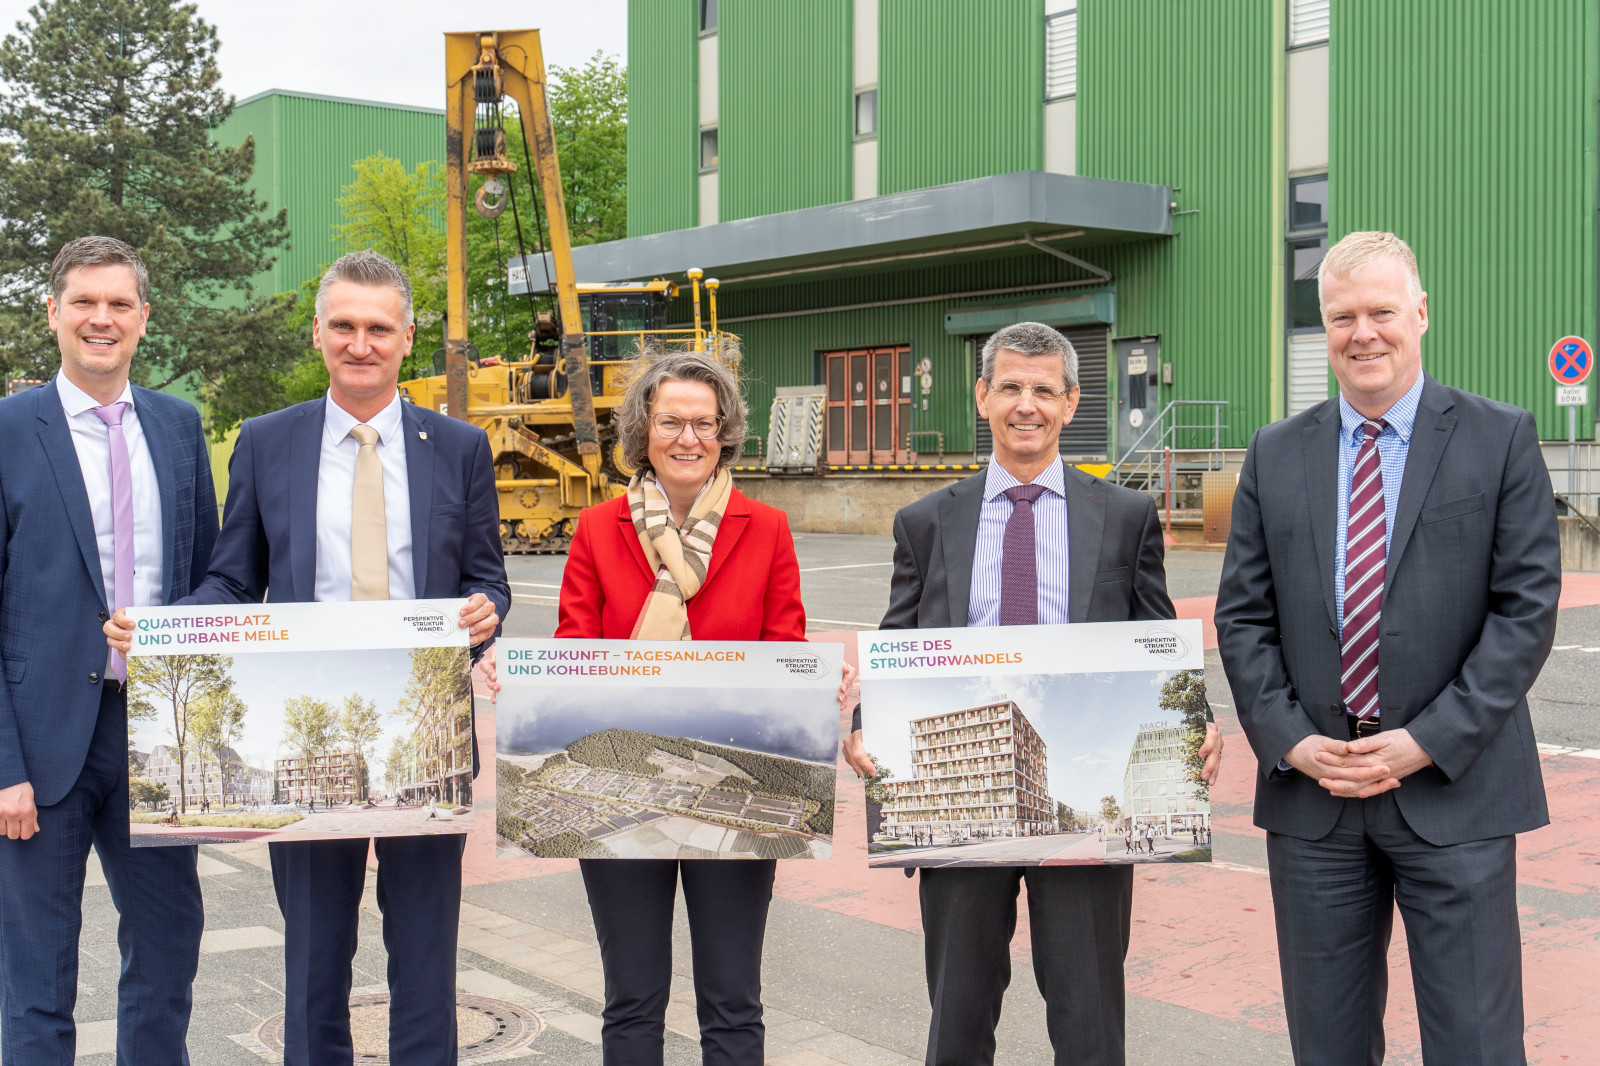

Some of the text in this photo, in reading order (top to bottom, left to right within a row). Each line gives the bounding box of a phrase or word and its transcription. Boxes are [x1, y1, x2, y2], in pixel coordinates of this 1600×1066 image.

[137, 615, 271, 631] QUARTIERSPLATZ
[138, 629, 289, 646] UND URBANE MEILE
[869, 639, 952, 654] ACHSE DES
[507, 649, 534, 661] DIE
[537, 650, 610, 662] ZUKUNFT
[624, 650, 746, 662] TAGESANLAGEN
[870, 652, 1023, 670] STRUKTURWANDELS
[507, 664, 662, 676] UND KOHLEBUNKER
[1139, 720, 1168, 731] MACH
